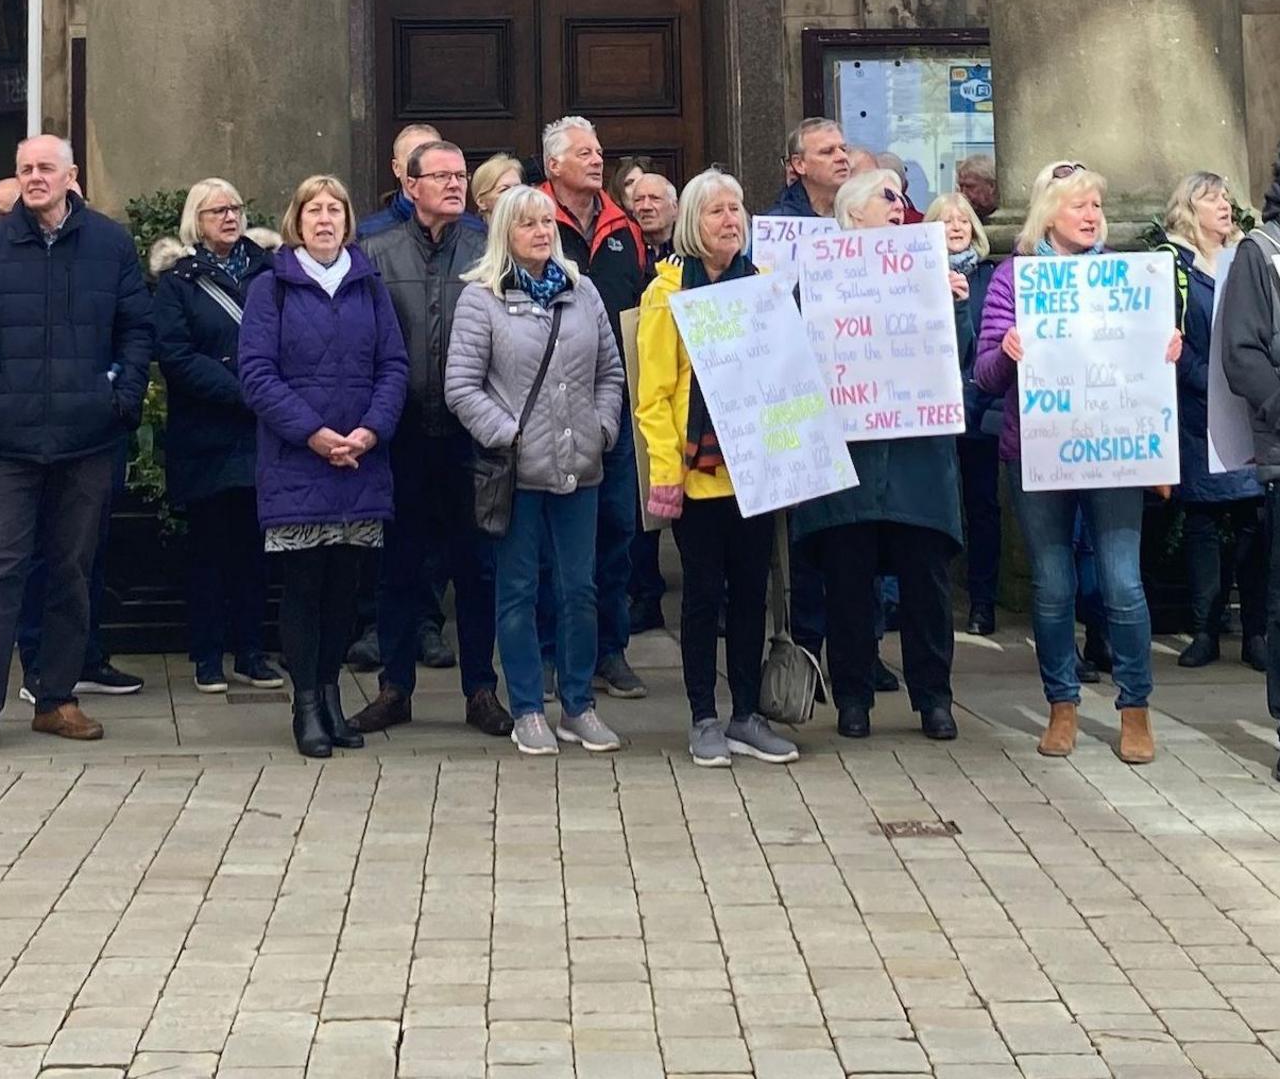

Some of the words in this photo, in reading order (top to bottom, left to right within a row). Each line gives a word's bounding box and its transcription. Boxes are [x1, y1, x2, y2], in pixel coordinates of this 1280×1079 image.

[812, 236, 862, 262] 5,761
[882, 253, 914, 275] NO
[1019, 260, 1079, 291] SAVE
[1087, 260, 1130, 288] OUR
[1019, 289, 1080, 316] TREES
[834, 316, 873, 339] YOU
[835, 364, 846, 385] ?
[1022, 388, 1071, 415] YOU
[865, 411, 903, 431] SAVE
[917, 404, 964, 428] TREES
[1161, 407, 1173, 433] ?
[1059, 433, 1163, 464] CONSIDER
